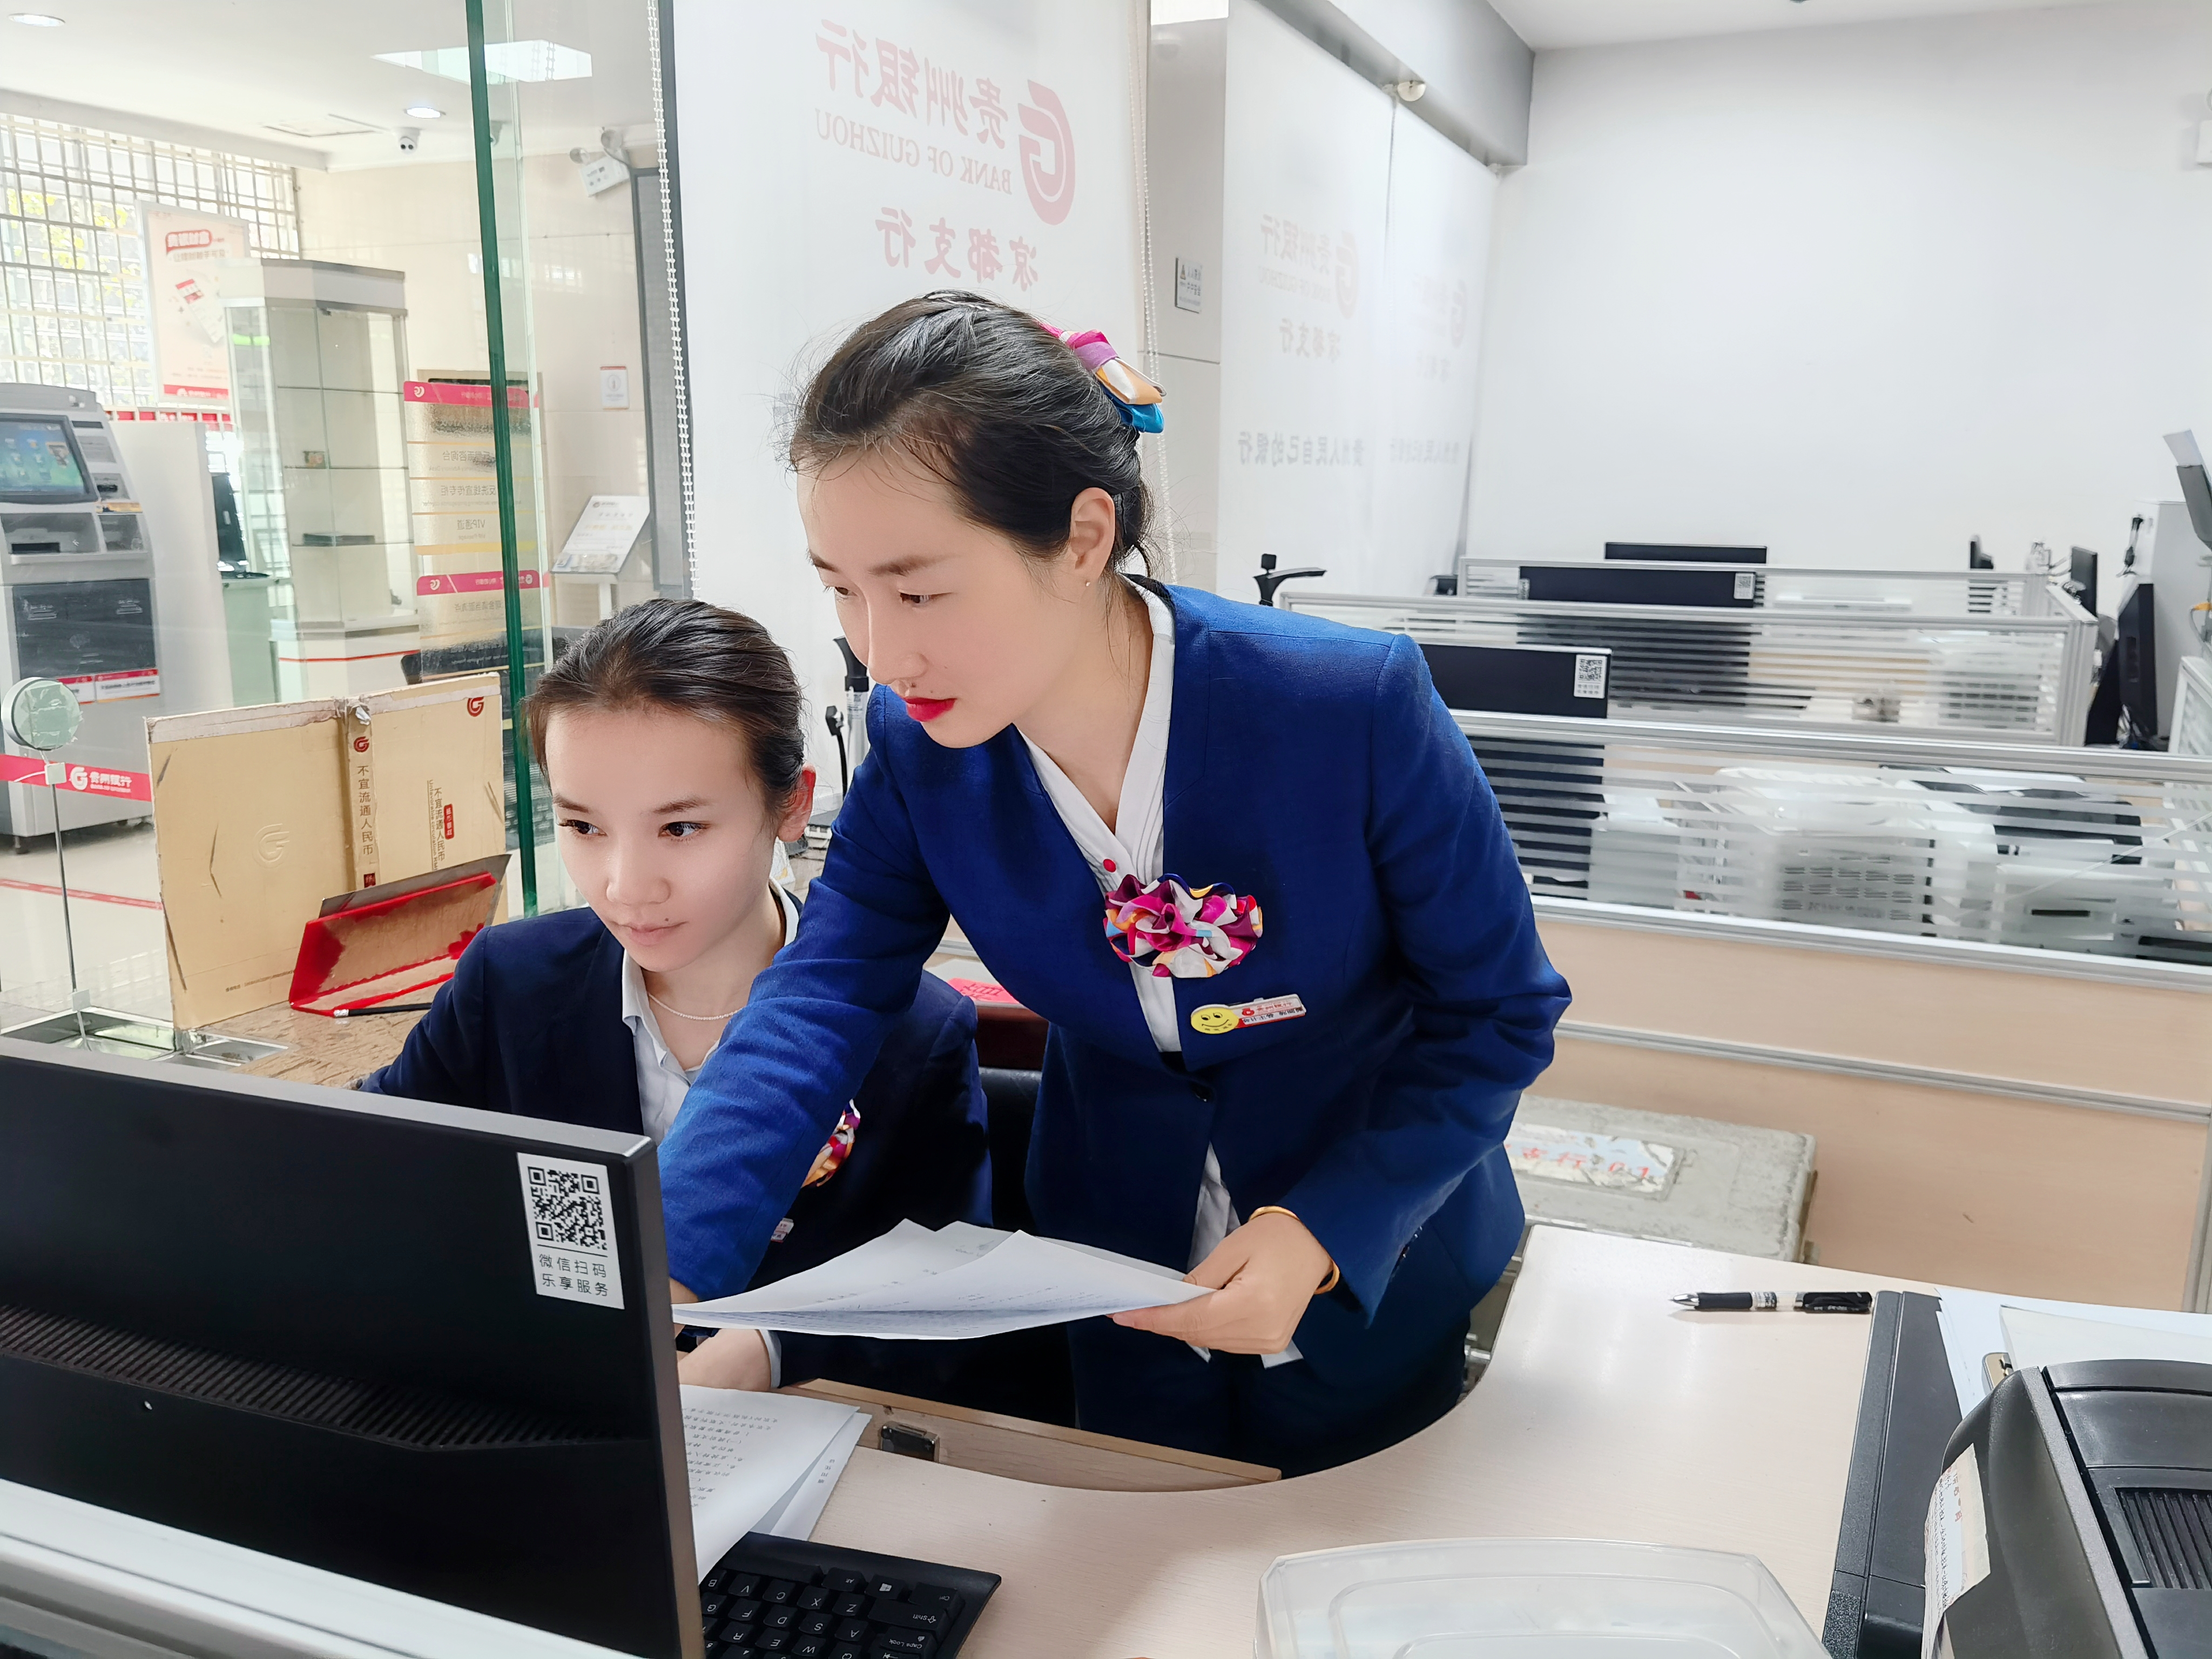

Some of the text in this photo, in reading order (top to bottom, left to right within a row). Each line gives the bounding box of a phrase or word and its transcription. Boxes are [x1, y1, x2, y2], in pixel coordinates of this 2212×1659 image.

[357, 765, 373, 855] 不宜流通人民币
[434, 787, 446, 862] 不宜流通人民币
[539, 1253, 607, 1278] 微信扫码
[542, 1273, 608, 1297] 乐享服务
[708, 1579, 718, 1587] B
[741, 1585, 750, 1593] V
[776, 1591, 786, 1600] C
[811, 1598, 821, 1606] X
[707, 1604, 717, 1612] G
[846, 1604, 857, 1612] Z
[741, 1609, 752, 1617] F
[777, 1616, 787, 1624] D
[814, 1623, 823, 1631] S
[889, 1638, 905, 1647] Lock
